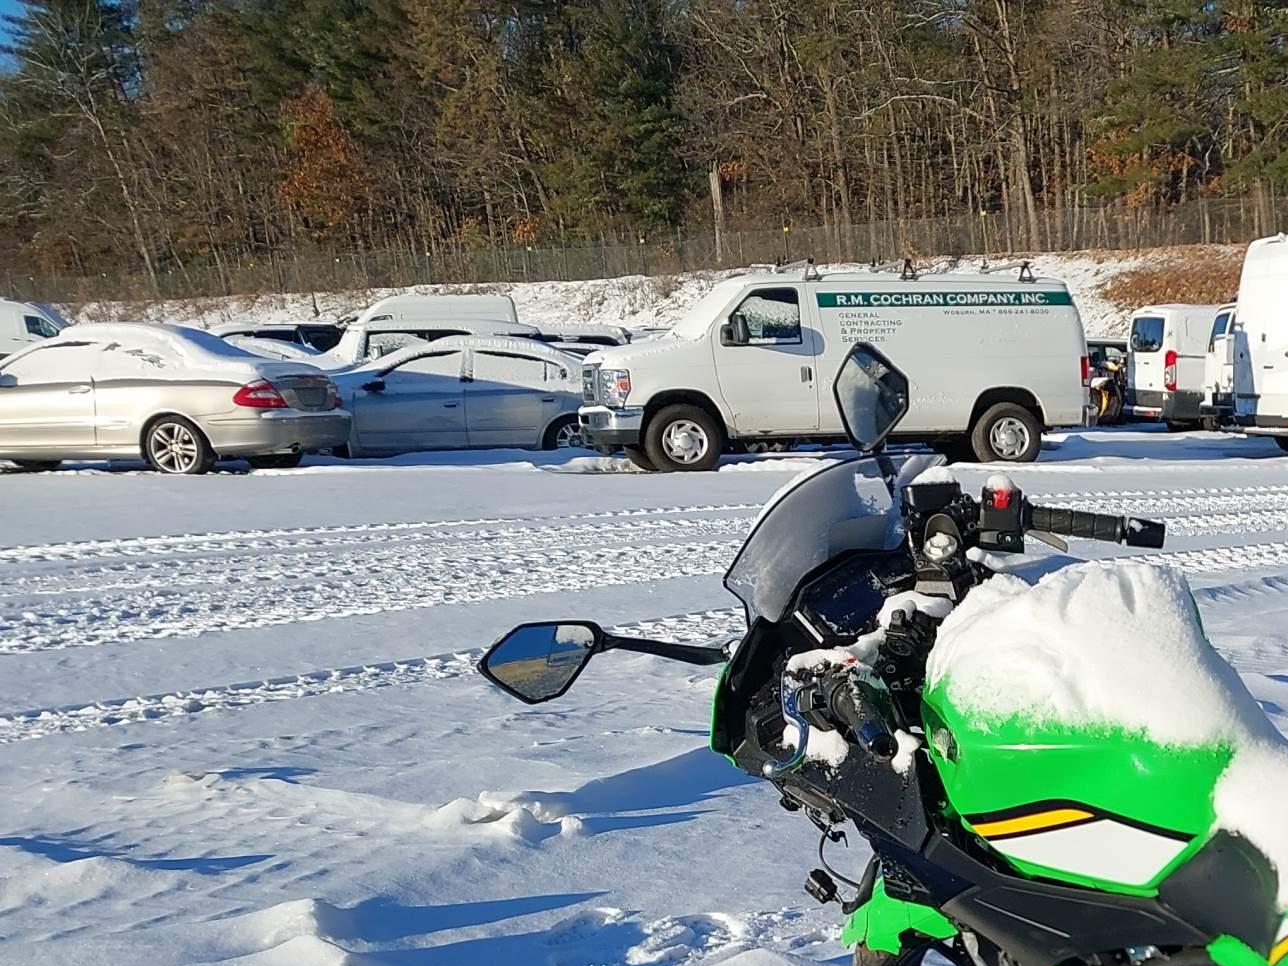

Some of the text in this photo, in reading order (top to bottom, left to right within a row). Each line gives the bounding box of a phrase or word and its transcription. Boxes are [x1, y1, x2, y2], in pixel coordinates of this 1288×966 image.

[836, 293, 1049, 305] R.M. COCHRAN COMPANY, INC.
[850, 327, 896, 335] PROPERTY
